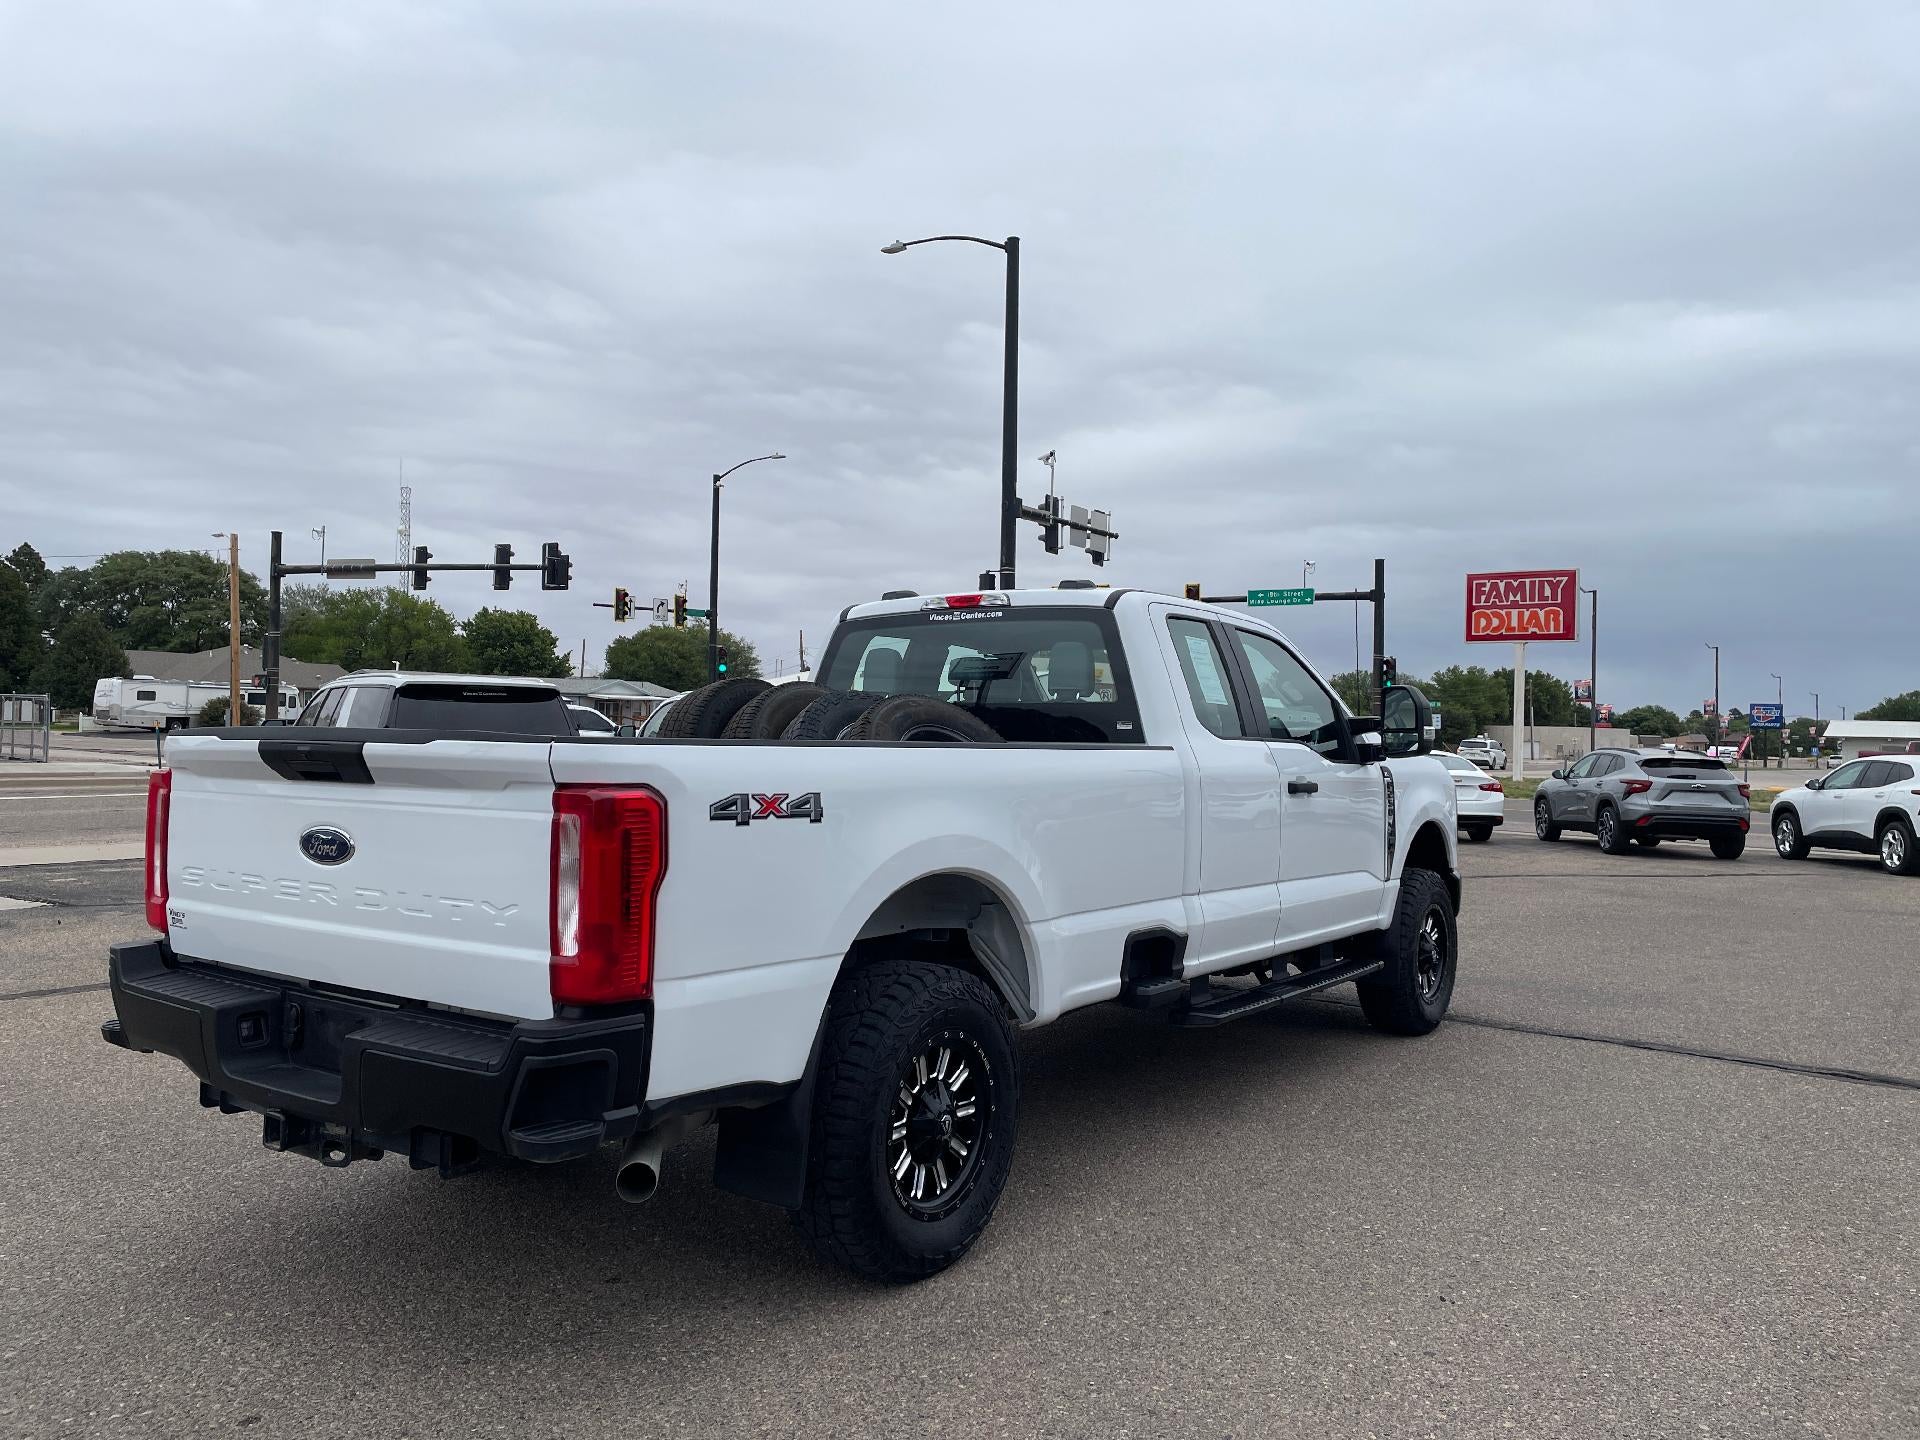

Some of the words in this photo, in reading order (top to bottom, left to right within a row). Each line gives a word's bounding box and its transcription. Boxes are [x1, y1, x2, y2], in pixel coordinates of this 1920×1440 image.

[1472, 577, 1568, 605] FAMILY
[1472, 607, 1563, 635] DOLLAR
[308, 833, 339, 857] Ford
[182, 865, 338, 905] SUPER
[354, 886, 520, 927] DUTY
